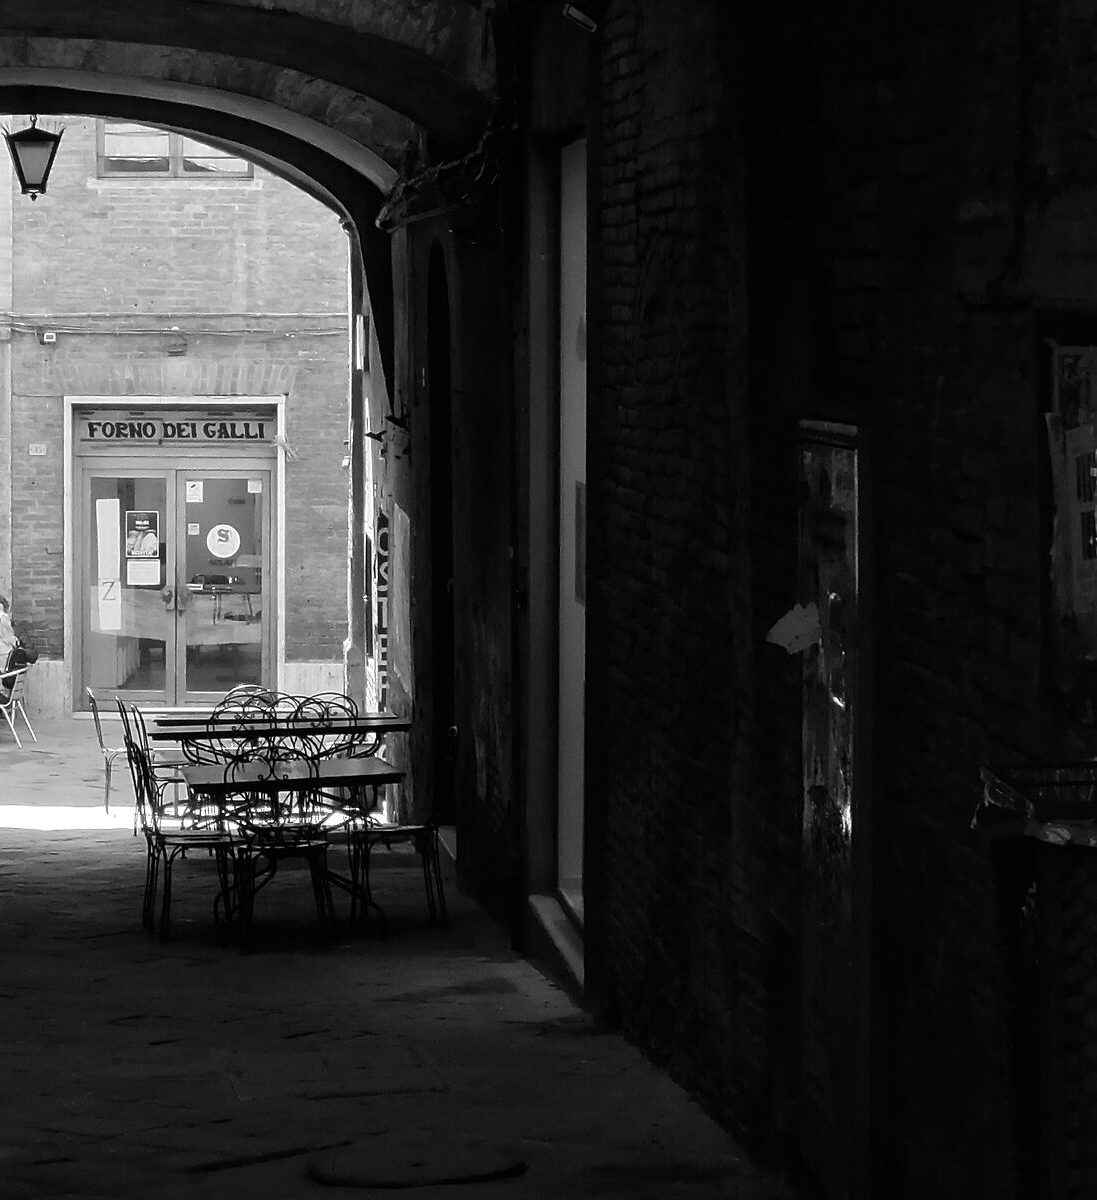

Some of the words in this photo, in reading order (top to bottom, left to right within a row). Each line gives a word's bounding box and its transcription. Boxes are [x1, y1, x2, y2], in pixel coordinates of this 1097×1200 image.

[87, 422, 156, 438] FORNO
[162, 422, 197, 439] DEI
[202, 422, 265, 439] GALLI
